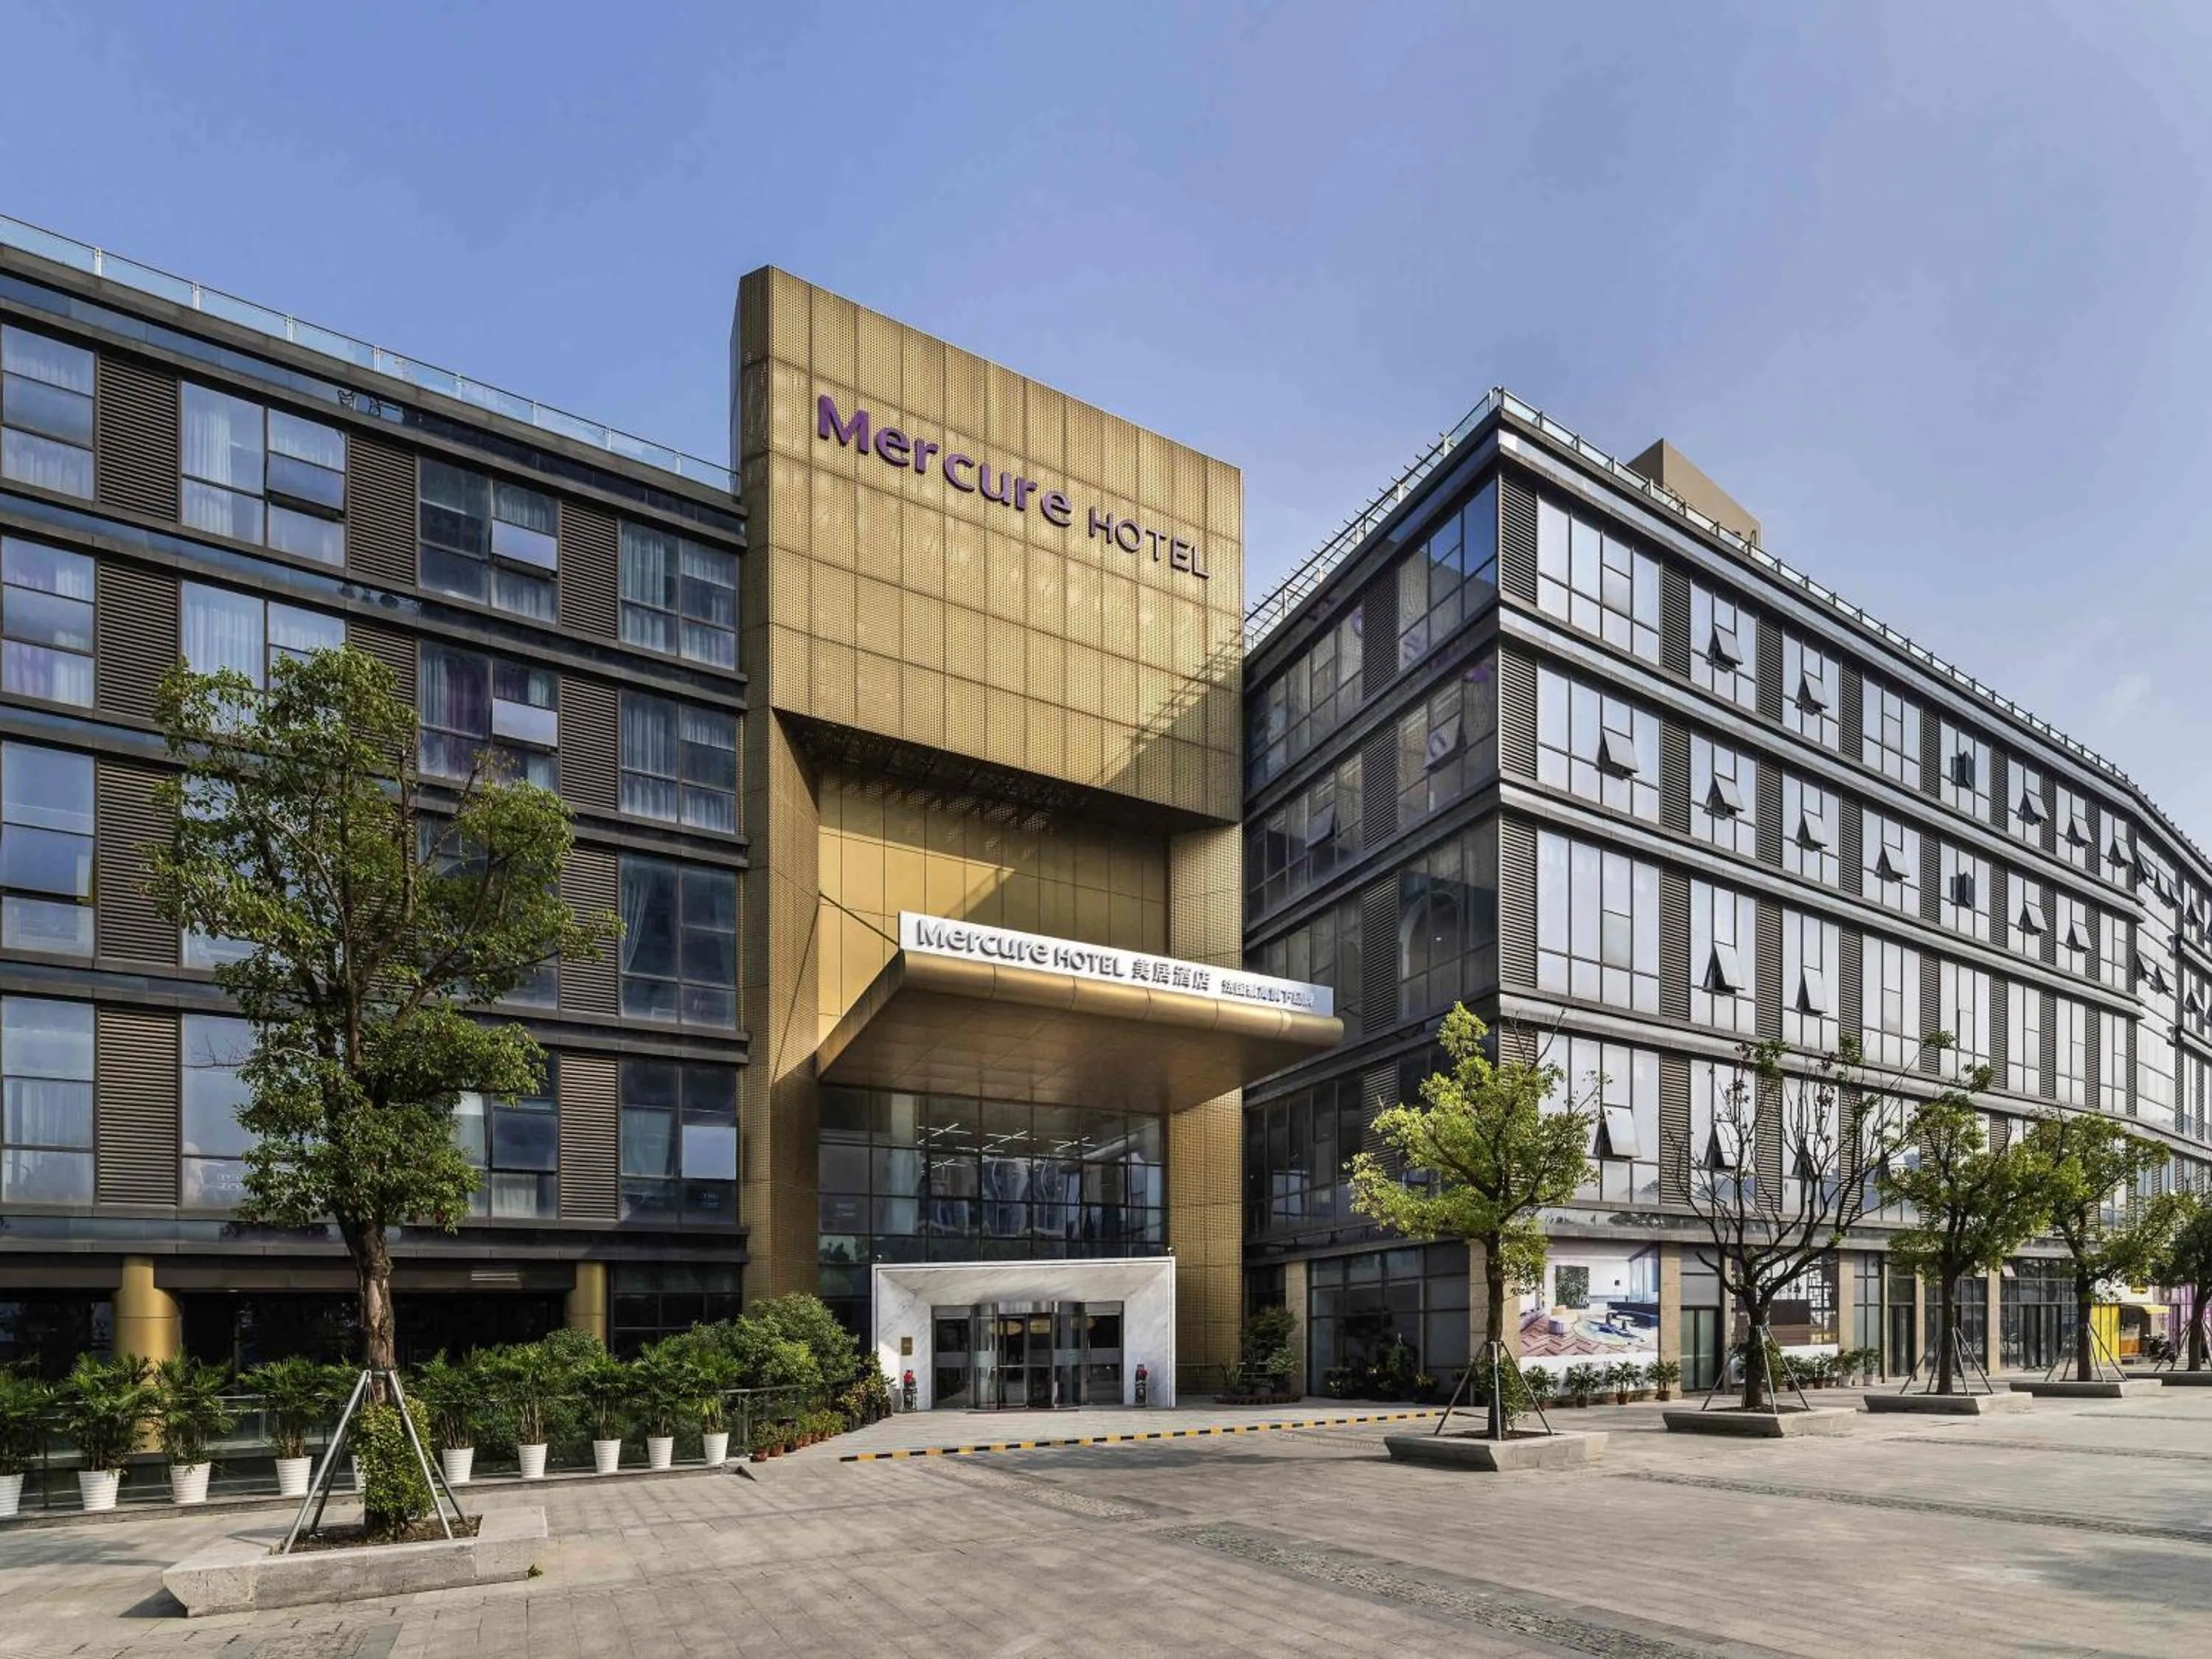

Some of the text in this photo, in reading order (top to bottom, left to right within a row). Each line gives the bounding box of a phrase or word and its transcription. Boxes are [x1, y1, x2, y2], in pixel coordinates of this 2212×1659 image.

[817, 394, 1210, 580] Mercure HOTEL
[916, 918, 1048, 964] Mercure
[1054, 945, 1124, 978] HOTEL
